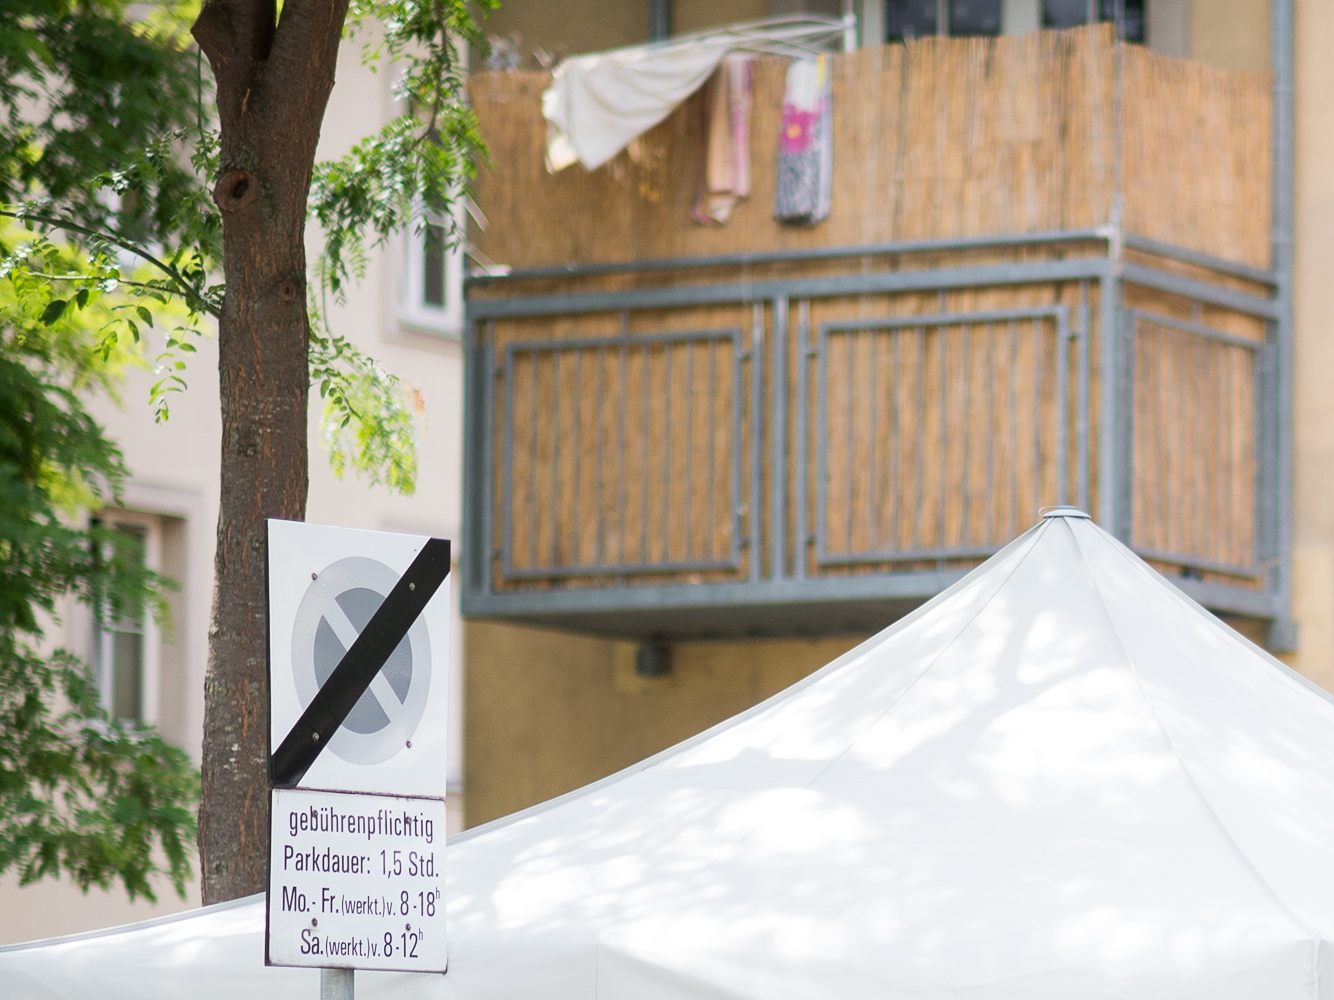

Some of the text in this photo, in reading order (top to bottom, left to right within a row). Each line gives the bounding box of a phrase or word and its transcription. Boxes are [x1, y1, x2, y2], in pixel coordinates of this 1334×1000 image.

[289, 806, 433, 844] gebührenpflichtig
[284, 845, 439, 878] Parkdauer: 1,5 Std.
